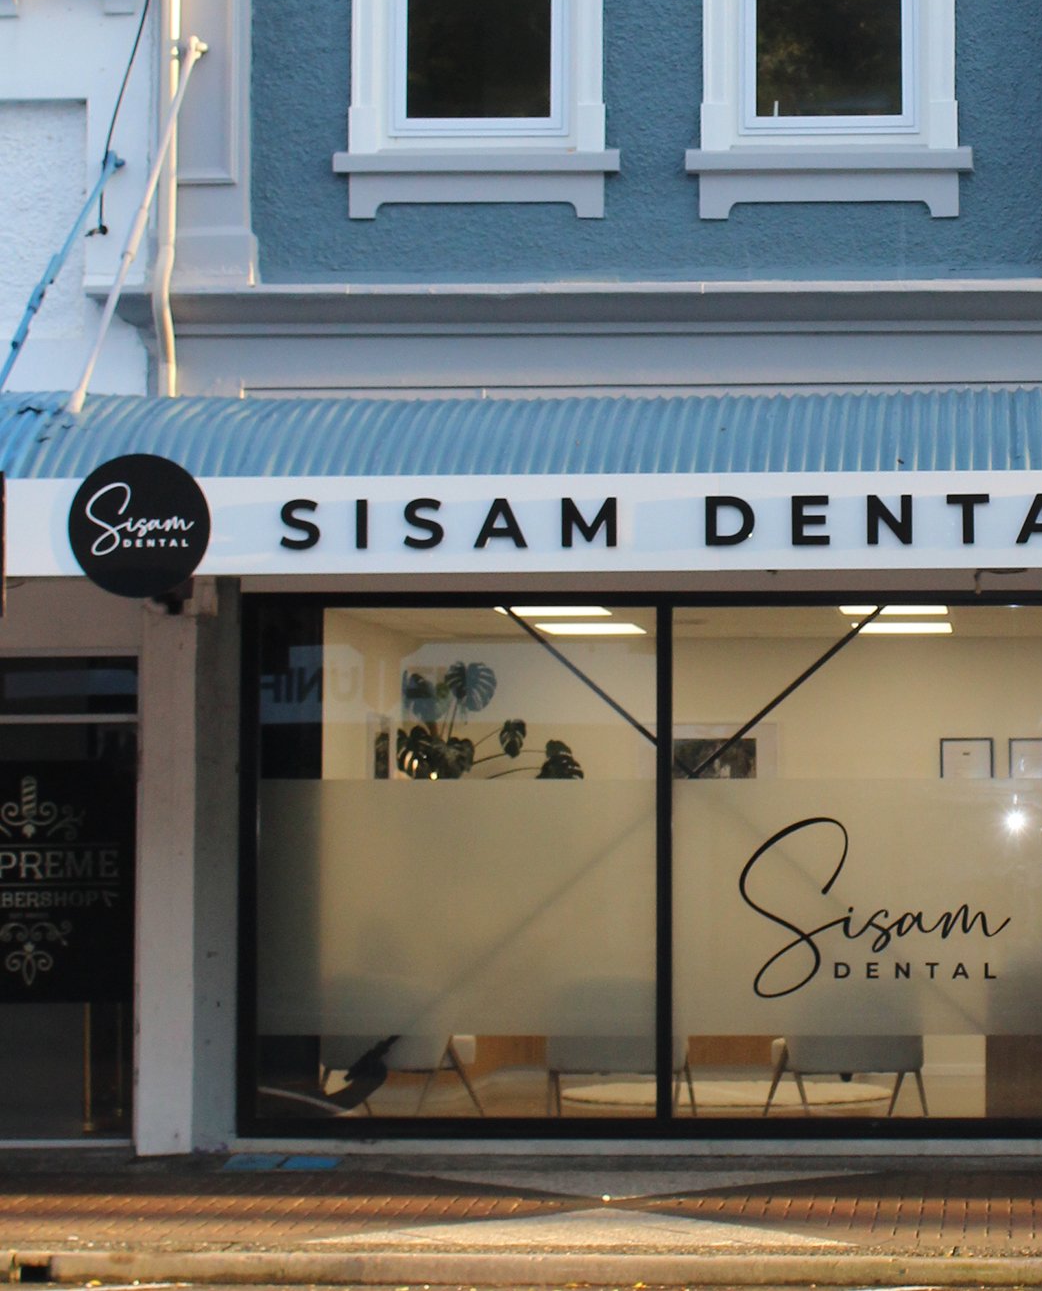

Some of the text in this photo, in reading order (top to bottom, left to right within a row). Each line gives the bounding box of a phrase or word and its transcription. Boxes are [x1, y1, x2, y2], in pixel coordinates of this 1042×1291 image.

[85, 482, 195, 556] Sisam
[122, 538, 189, 548] DENTAL
[280, 497, 617, 550] SISAM
[739, 817, 1011, 998] Sisam
[833, 962, 997, 980] DENTAL
